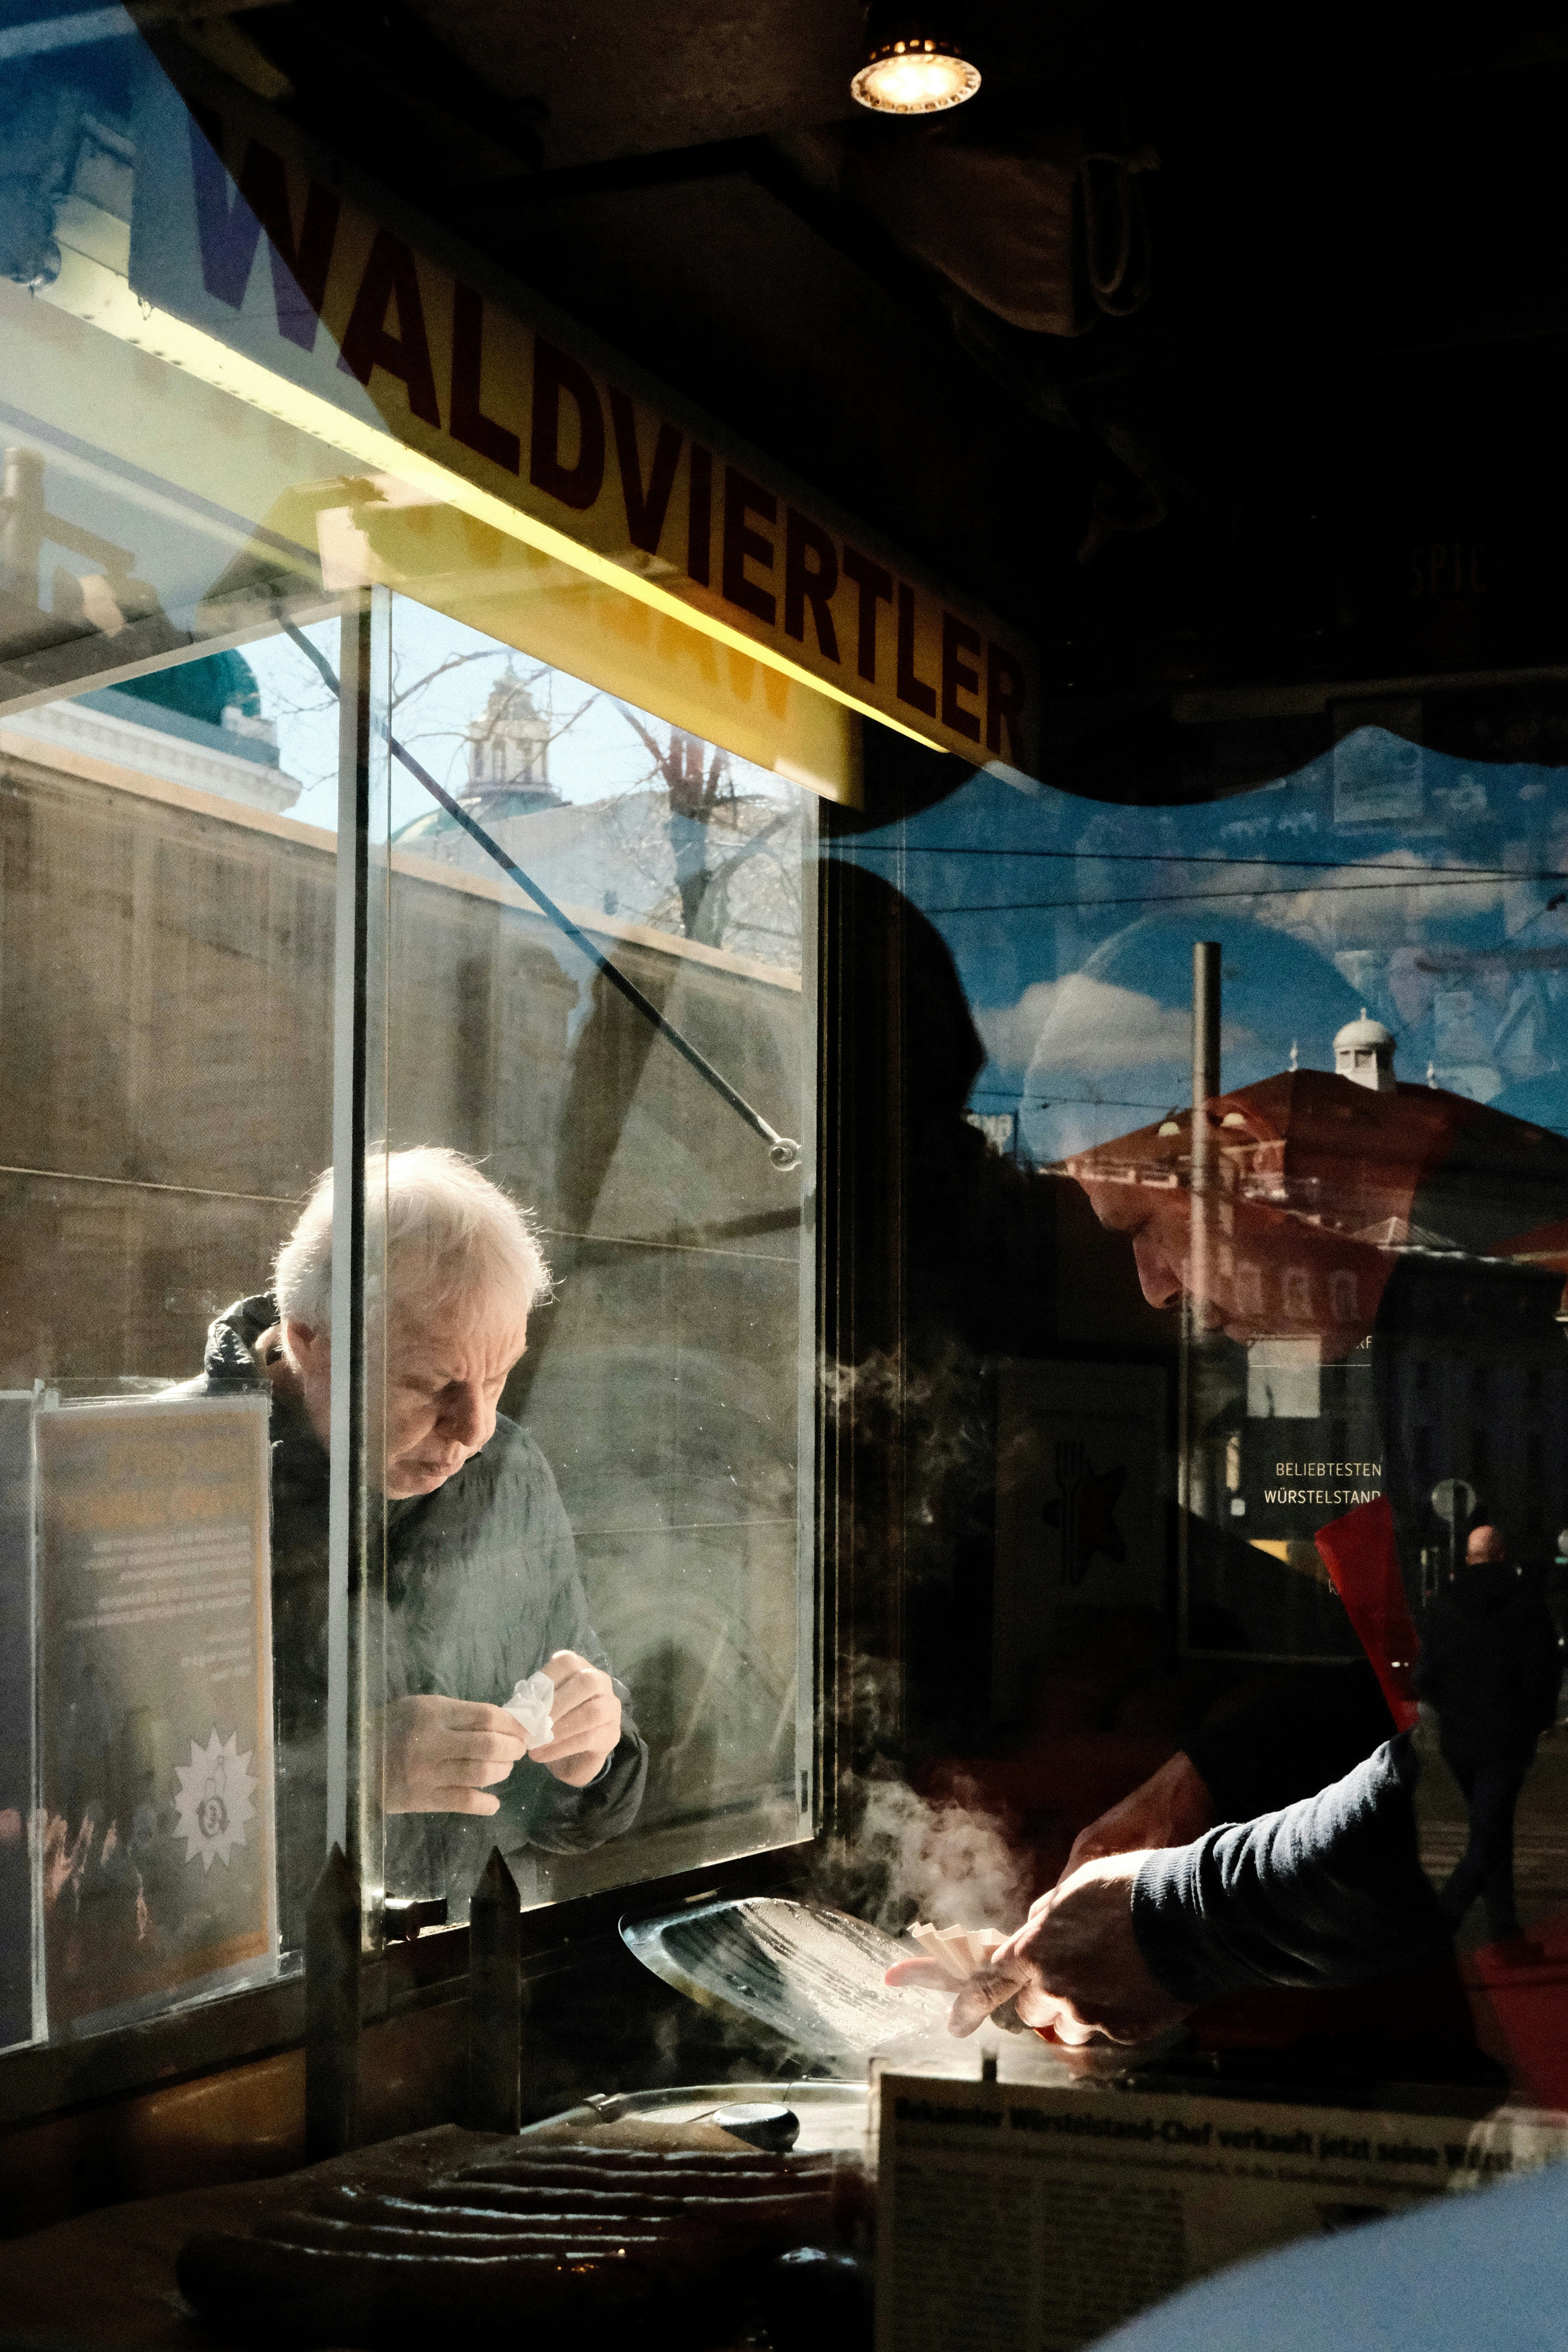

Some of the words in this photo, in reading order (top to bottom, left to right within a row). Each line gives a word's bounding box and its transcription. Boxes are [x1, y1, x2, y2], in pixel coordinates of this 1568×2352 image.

[188, 99, 1031, 772] WALDVIERTLER
[1276, 1462, 1381, 1477] BELIEBTESTEN
[1264, 1487, 1381, 1504] WÜRSTELSTAND
